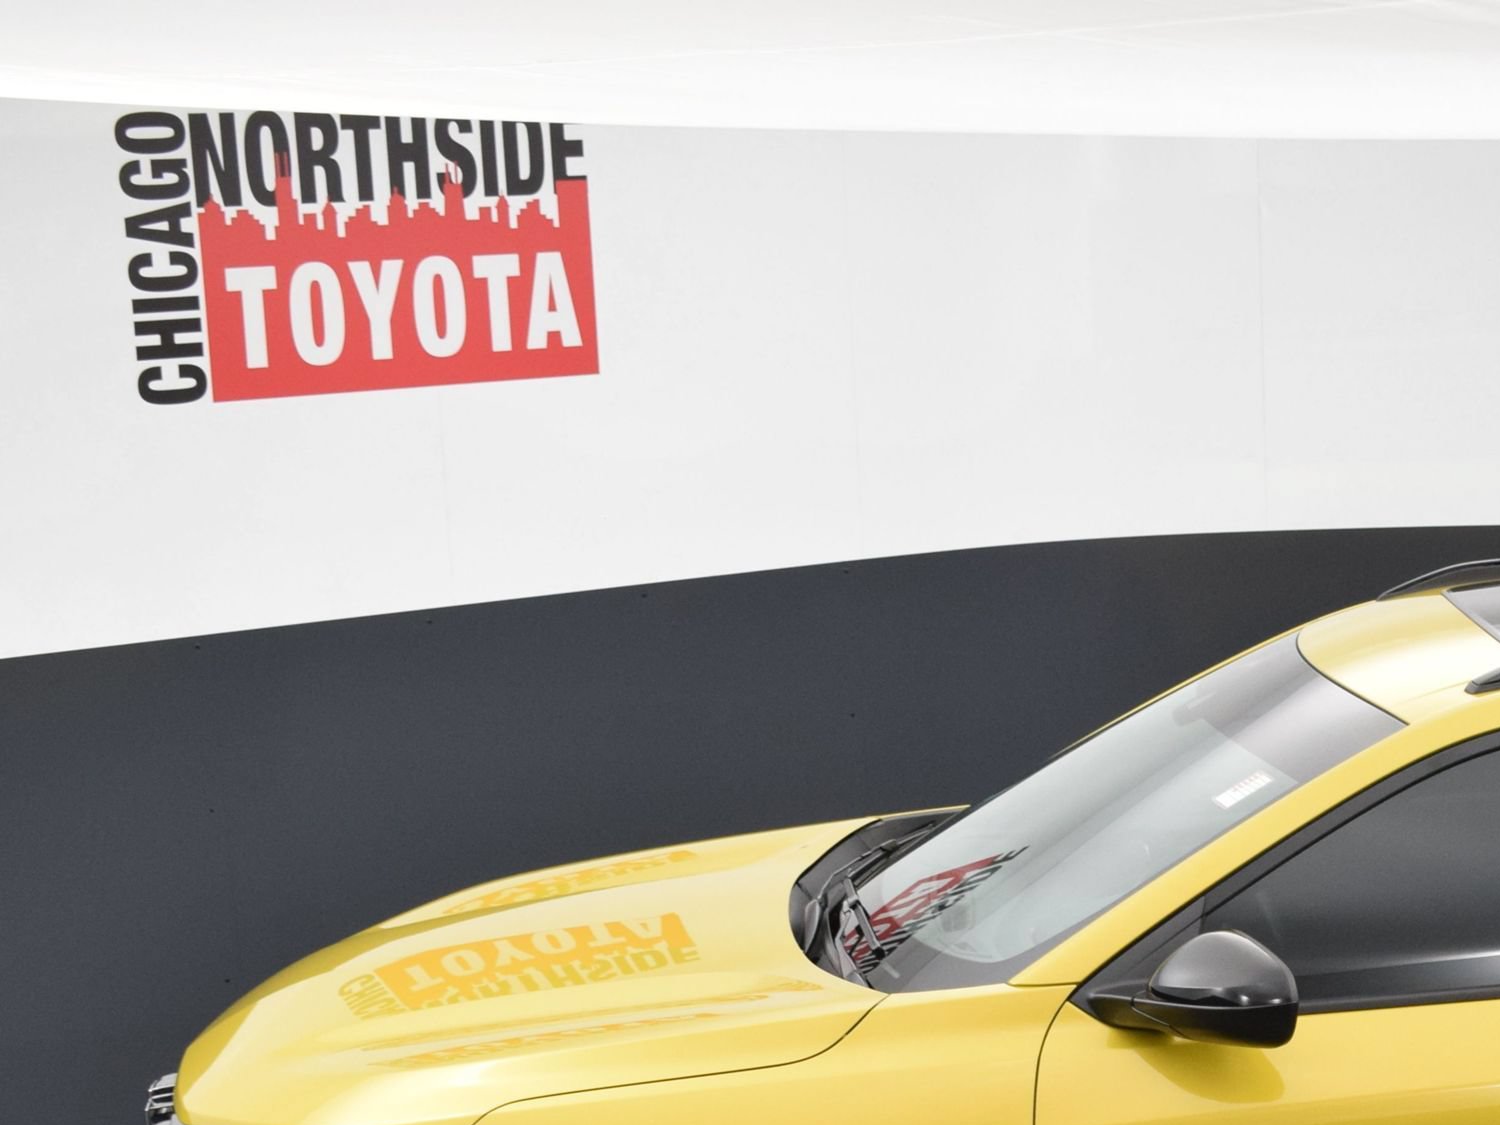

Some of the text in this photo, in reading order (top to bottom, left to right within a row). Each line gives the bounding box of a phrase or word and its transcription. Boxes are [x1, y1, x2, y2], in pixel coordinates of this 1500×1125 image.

[188, 111, 587, 208] NORTHSIDE
[114, 111, 208, 404] CHICAGO
[226, 251, 583, 368] TOYOTA
